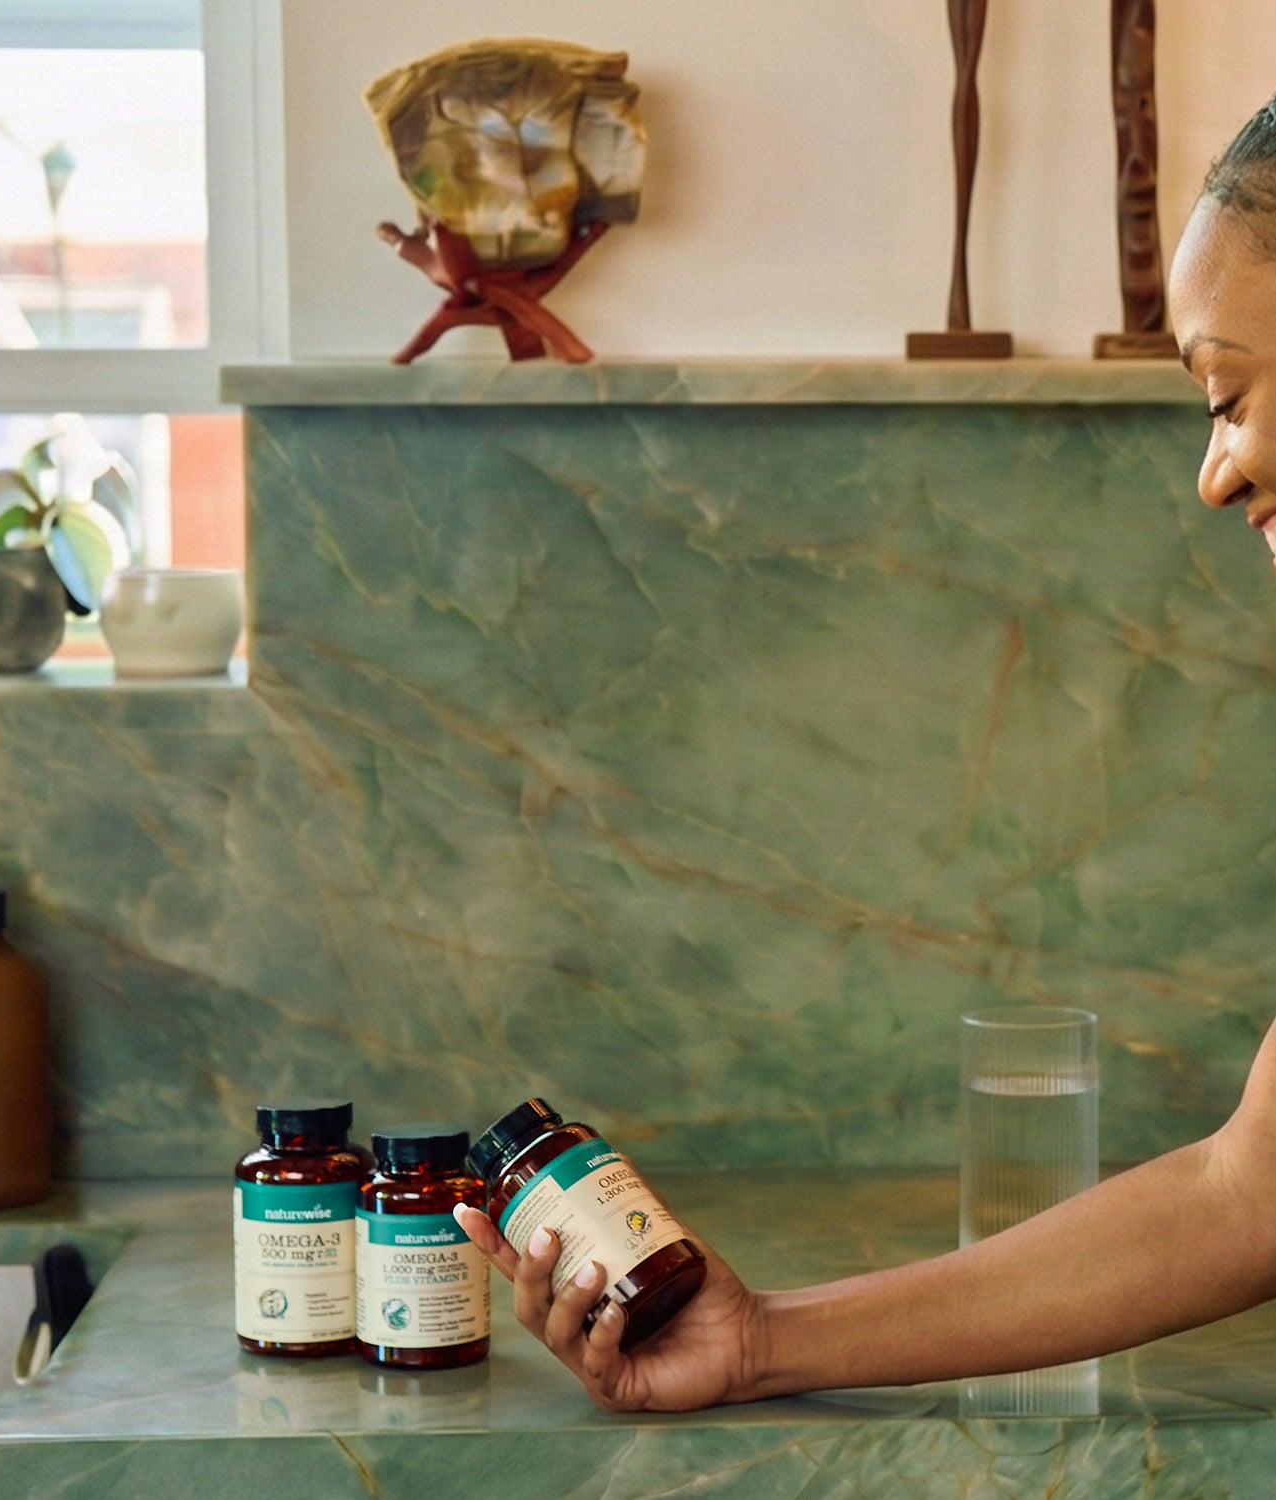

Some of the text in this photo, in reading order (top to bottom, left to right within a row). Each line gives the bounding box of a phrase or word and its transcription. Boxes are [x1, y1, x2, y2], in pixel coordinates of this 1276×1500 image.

[596, 1184, 626, 1205] 1,300
[264, 1204, 332, 1220] naturewise
[258, 1232, 341, 1248] OMEGA-3
[395, 1228, 456, 1244] naturewise
[262, 1248, 287, 1259] 500
[291, 1251, 314, 1262] mg
[394, 1252, 458, 1264] OMEGA-3
[416, 1266, 435, 1276] mg
[384, 1275, 411, 1285] PLUS
[413, 1274, 460, 1284] VITAMIN
